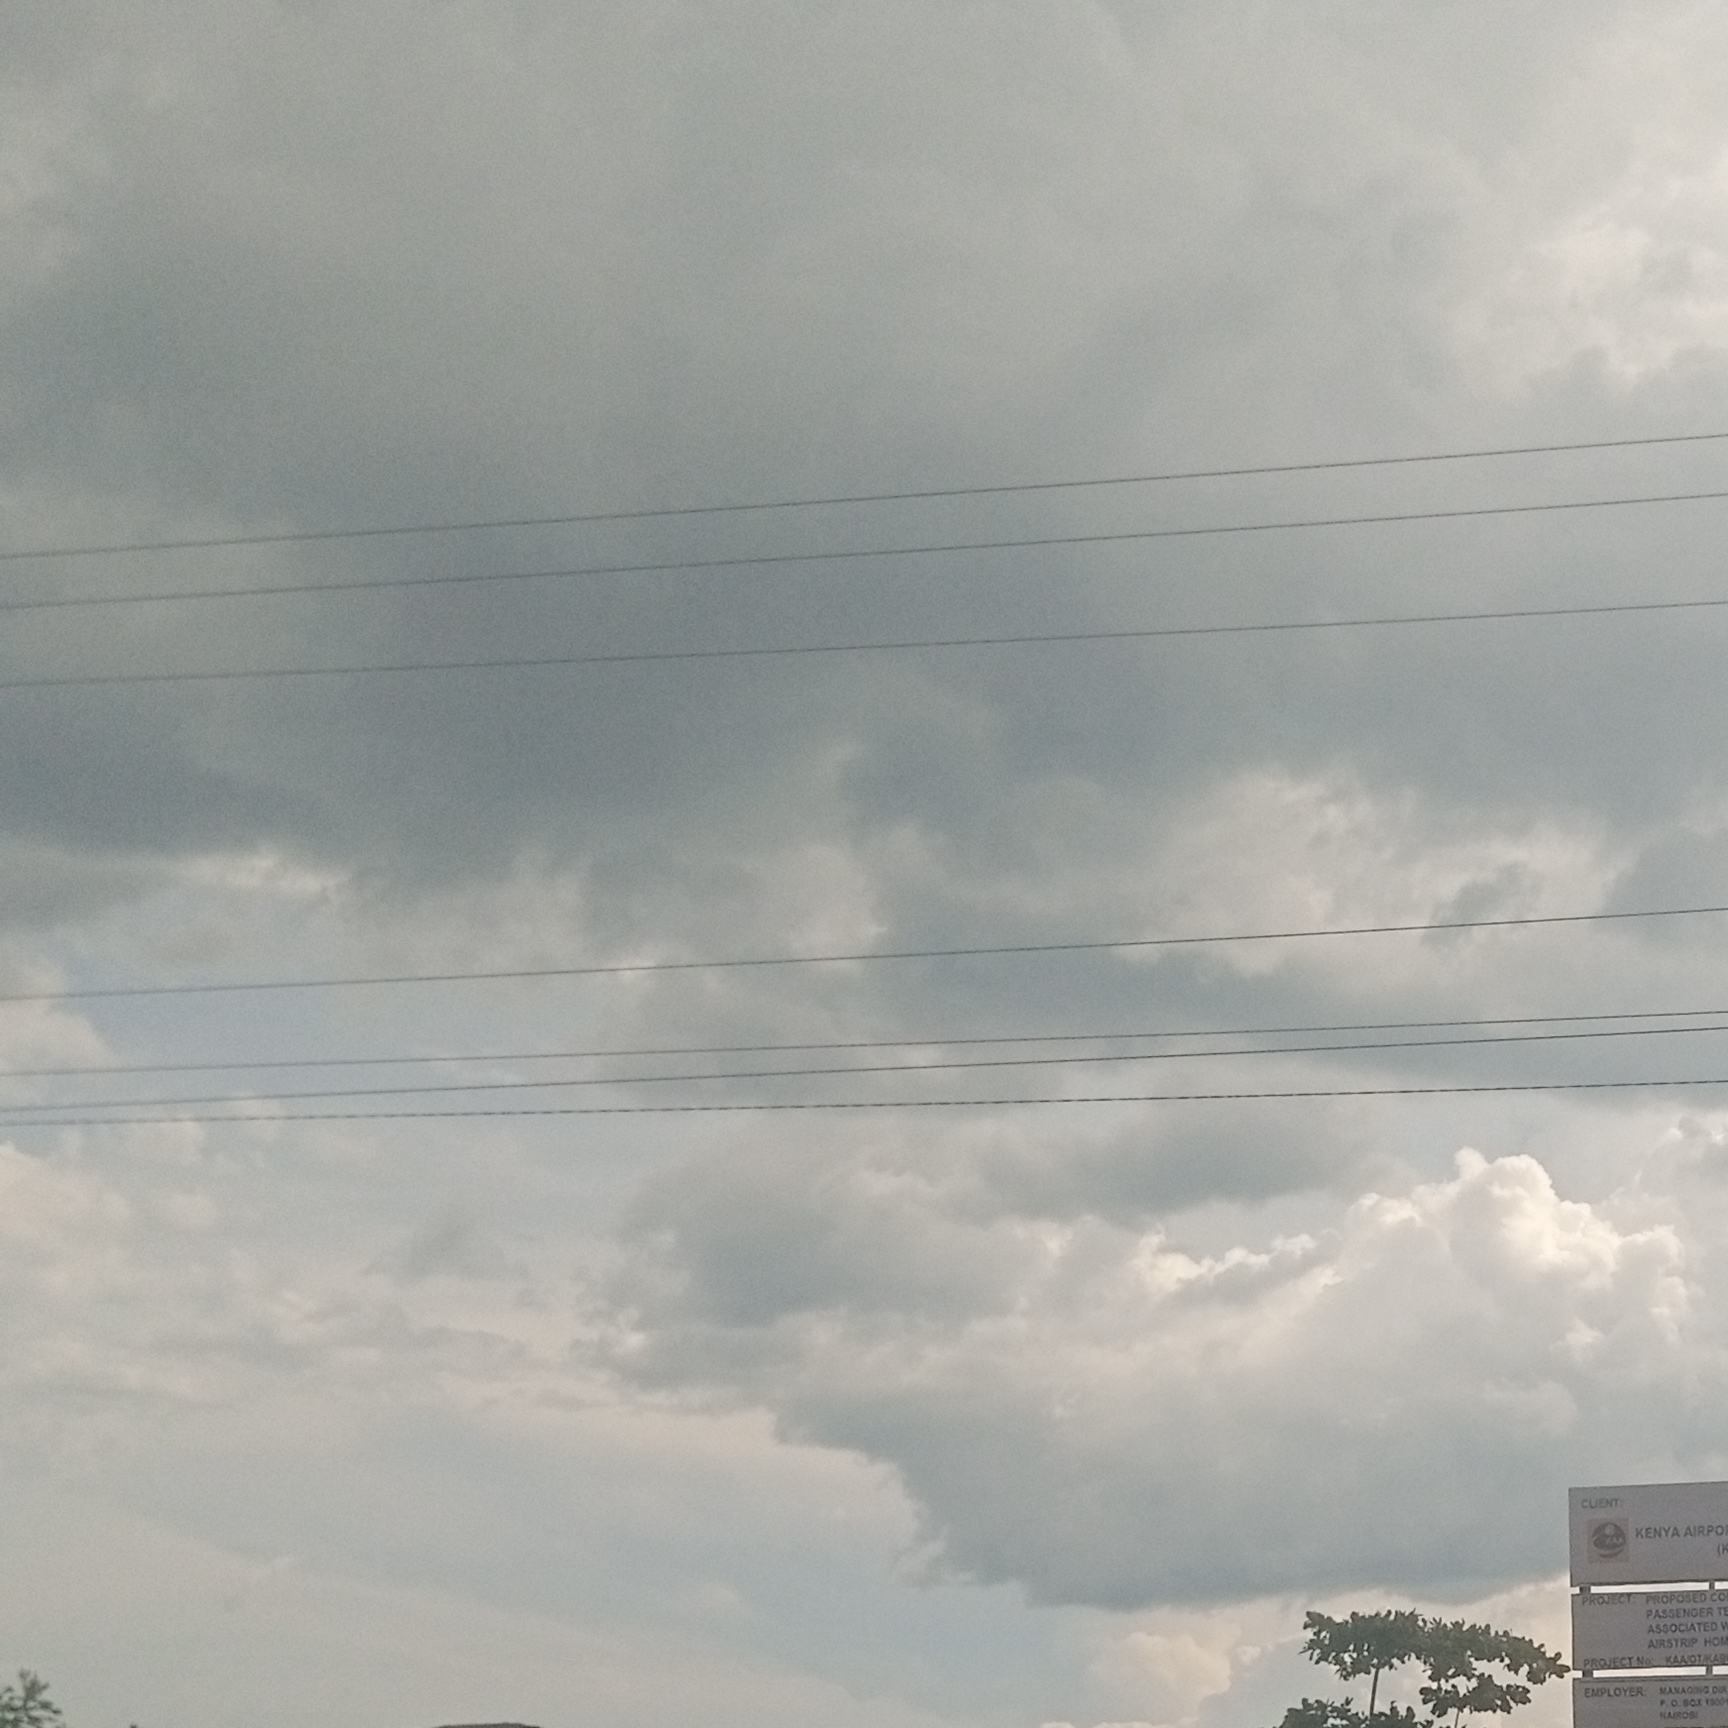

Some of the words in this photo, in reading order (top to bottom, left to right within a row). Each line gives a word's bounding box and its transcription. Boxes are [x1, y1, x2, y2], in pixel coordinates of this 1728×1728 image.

[1582, 1498, 1623, 1509] CLIENT:
[1635, 1526, 1679, 1539] KENYA
[1582, 1594, 1634, 1606] PROJECT:
[1647, 1592, 1706, 1604] PROPOSED
[1647, 1607, 1714, 1619] PASSENGER
[1648, 1621, 1717, 1634] ASSOCIATED
[1648, 1637, 1698, 1649] AIRSTRIP
[1584, 1657, 1635, 1668] PROJECT
[1584, 1687, 1647, 1698] EMPLOYER:
[1660, 1686, 1710, 1695] MANAGING
[1684, 1698, 1702, 1707] BOX
[1660, 1711, 1698, 1720] NAIROBI
